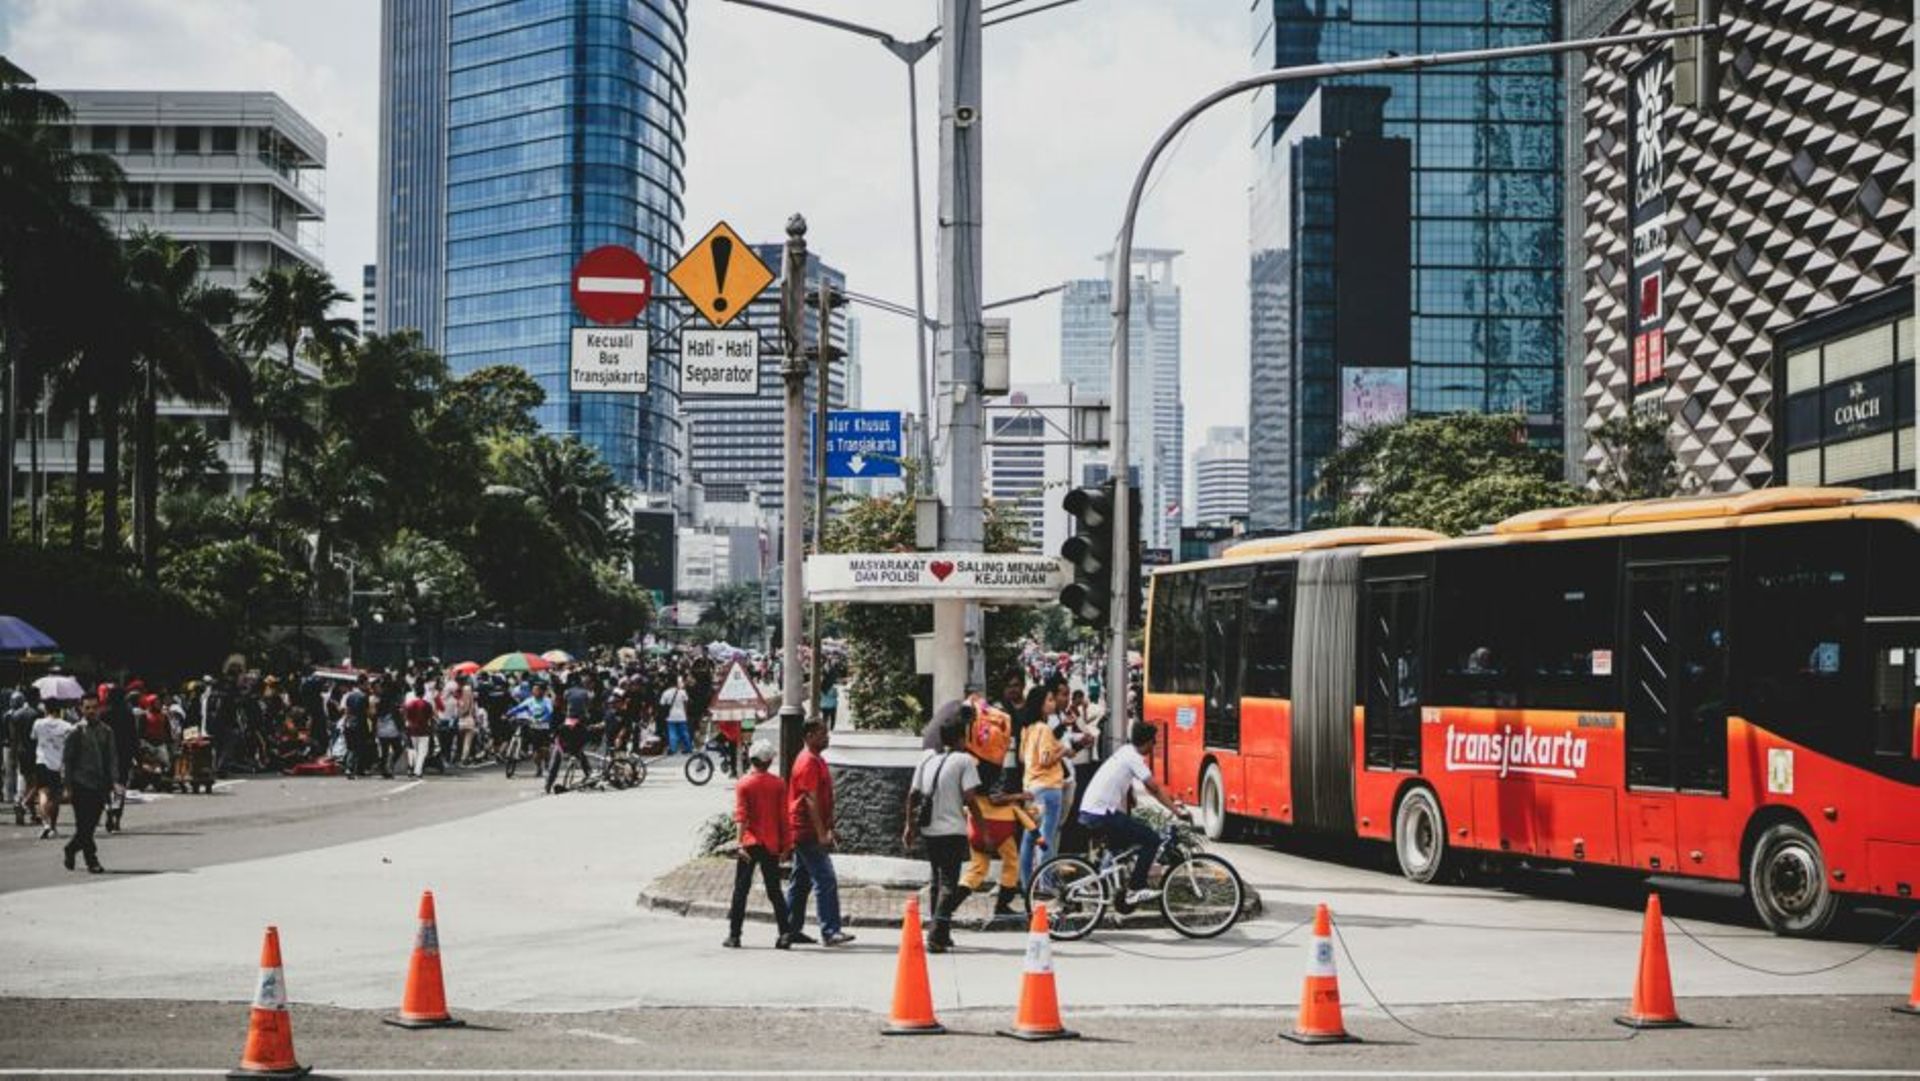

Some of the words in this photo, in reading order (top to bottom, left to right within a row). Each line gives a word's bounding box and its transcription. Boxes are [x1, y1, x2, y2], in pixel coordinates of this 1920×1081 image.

[587, 334, 633, 348] Kecuali
[687, 340, 715, 357] Hati
[726, 340, 753, 357] Hati
[599, 352, 619, 365] Bus
[573, 369, 646, 387] Transjakarta
[686, 365, 753, 385] Separator
[1834, 397, 1880, 425] COACH
[827, 417, 849, 432] alur
[854, 417, 891, 432] Khusus
[850, 560, 926, 572] MASYARAKAT
[957, 561, 1003, 573] SALING
[1007, 561, 1060, 573] MENJAGA
[855, 571, 878, 582] DAN
[881, 571, 919, 583] POLISI
[975, 573, 1046, 585] KEJUJURAN
[1446, 723, 1587, 778] transjakarta
